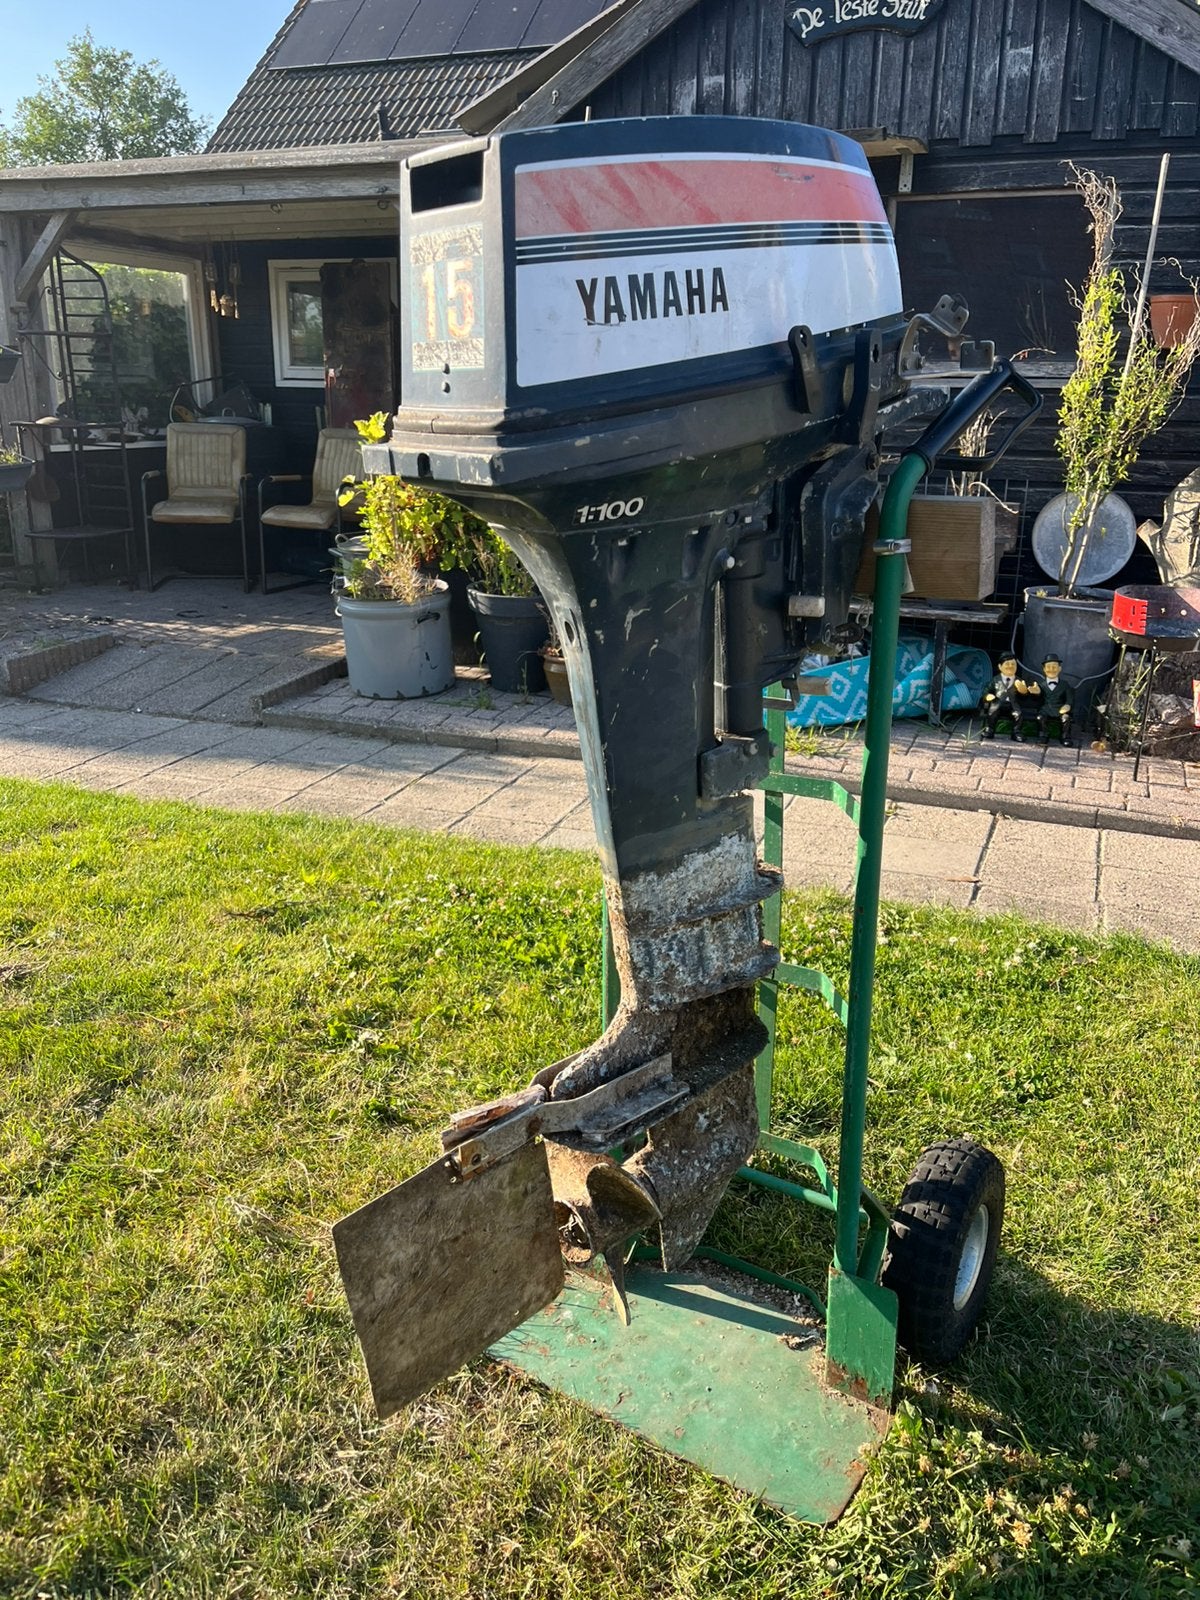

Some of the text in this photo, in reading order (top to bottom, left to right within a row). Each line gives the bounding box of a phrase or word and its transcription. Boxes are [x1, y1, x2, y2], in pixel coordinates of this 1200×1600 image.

[792, 7, 825, 38] De
[421, 258, 475, 341] 15
[575, 267, 730, 326] YAMAHA
[577, 497, 644, 523] 1:100
